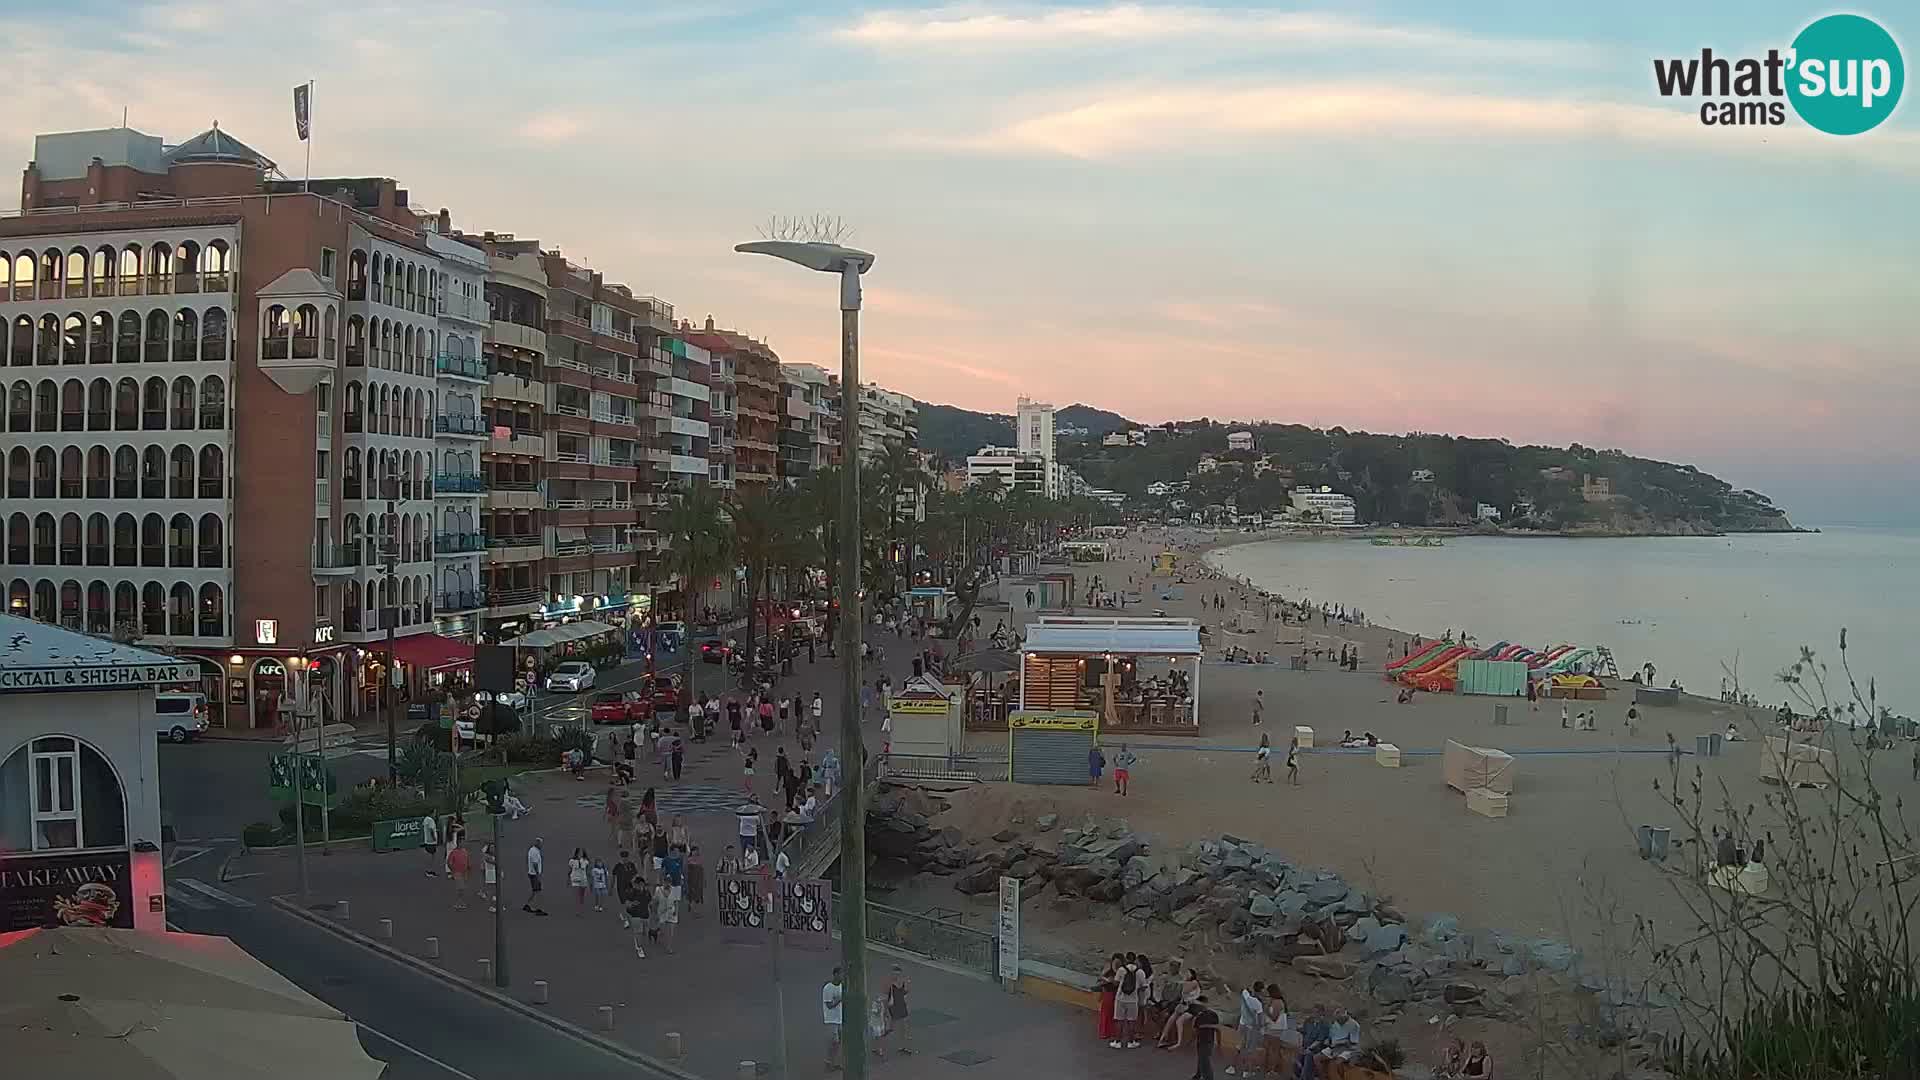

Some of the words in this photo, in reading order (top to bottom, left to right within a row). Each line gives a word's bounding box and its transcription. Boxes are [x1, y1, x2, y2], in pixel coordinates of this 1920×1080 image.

[315, 626, 334, 643] KFC
[64, 670, 76, 684] &
[80, 668, 143, 684] SHISHA
[146, 667, 179, 681] BAR
[258, 665, 283, 675] KFC
[395, 820, 421, 833] lloret
